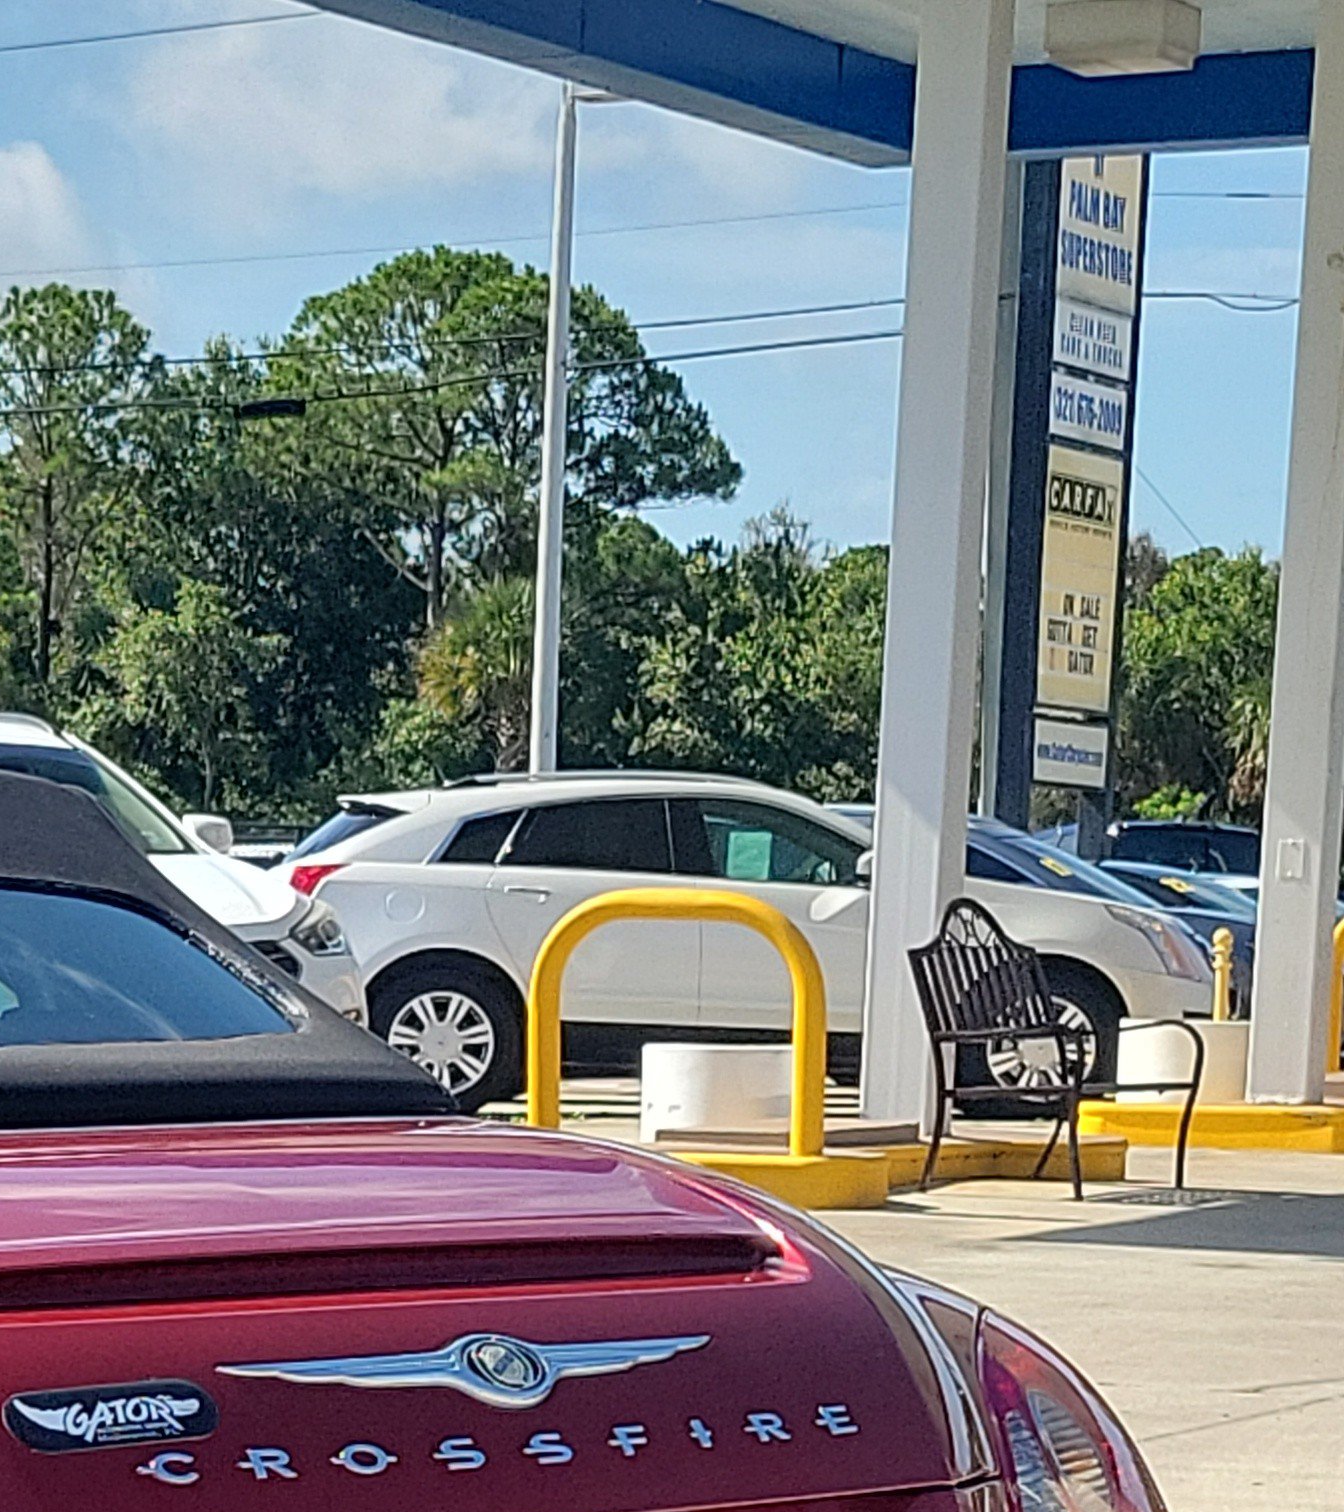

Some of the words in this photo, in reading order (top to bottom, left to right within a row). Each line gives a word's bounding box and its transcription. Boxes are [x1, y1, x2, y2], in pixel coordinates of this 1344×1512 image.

[1069, 179, 1100, 225] PALM
[1103, 189, 1127, 234] BAY
[1061, 229, 1132, 286] SUPERSTORE
[1050, 477, 1116, 526] CARFAX
[65, 1396, 185, 1443] GATOR
[136, 1405, 859, 1485] CROSSFIRE
